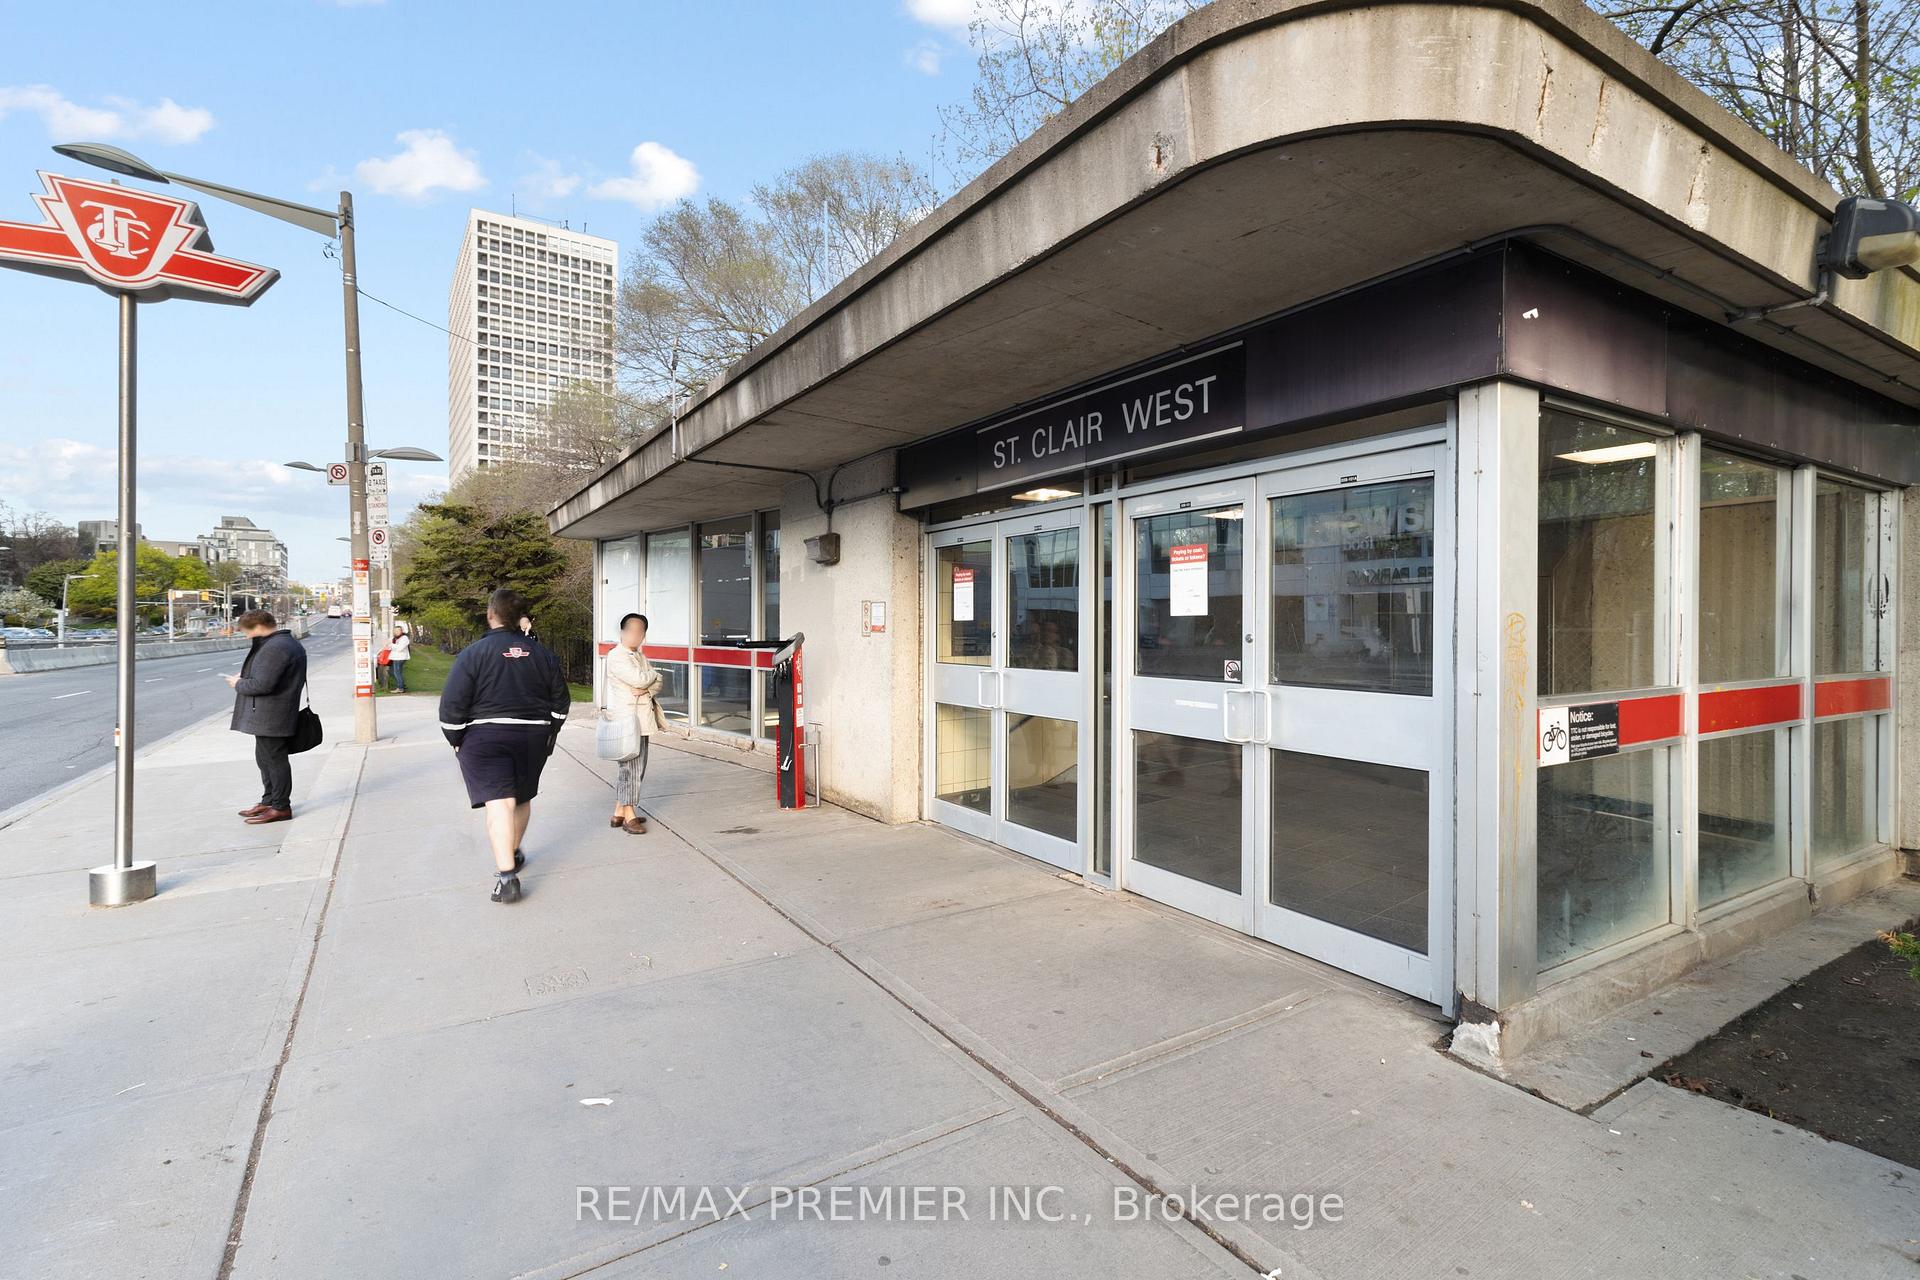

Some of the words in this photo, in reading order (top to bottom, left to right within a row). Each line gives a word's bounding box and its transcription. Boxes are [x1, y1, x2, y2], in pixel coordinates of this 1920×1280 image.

[80, 199, 151, 260] TTC
[993, 435, 1021, 469] ST.
[1031, 411, 1103, 458] CLAIR
[1122, 375, 1217, 434] WEST
[1570, 710, 1594, 723] Notice:
